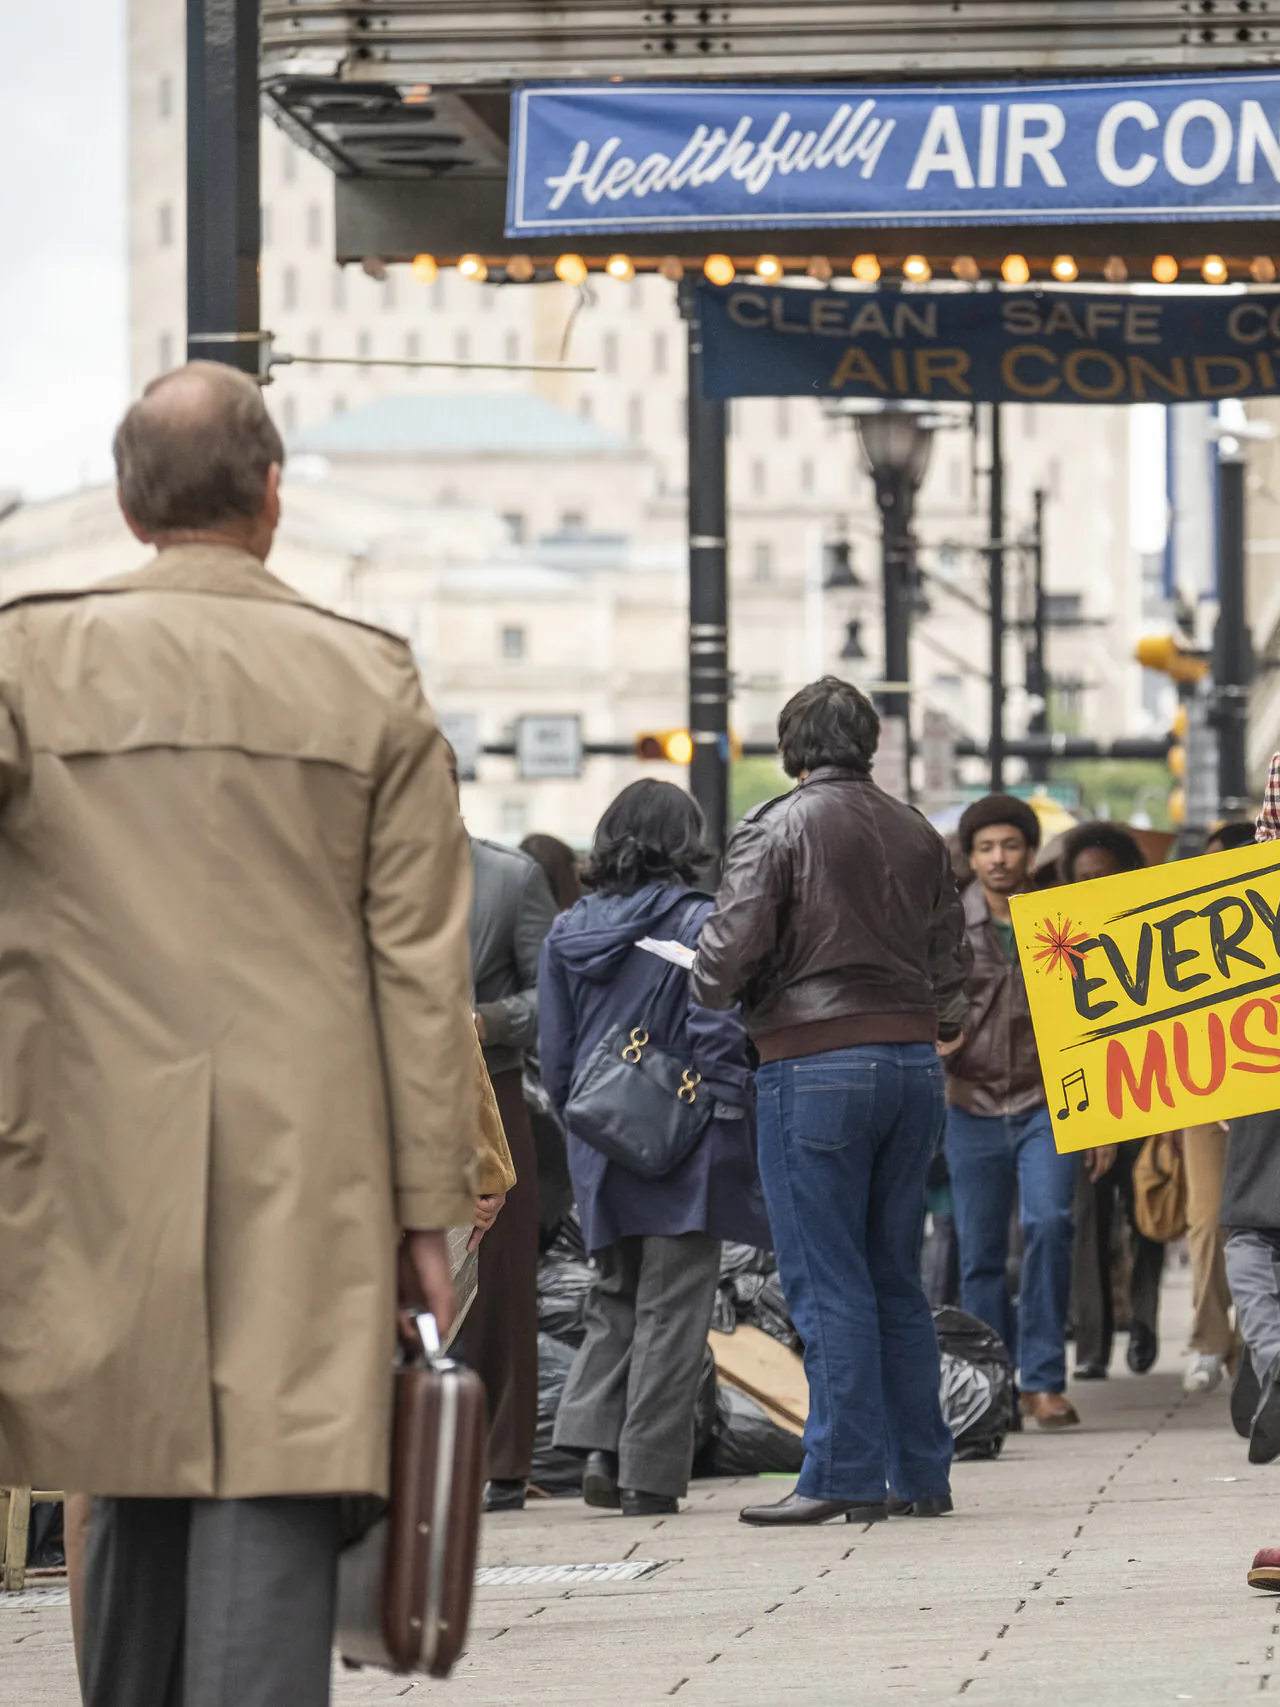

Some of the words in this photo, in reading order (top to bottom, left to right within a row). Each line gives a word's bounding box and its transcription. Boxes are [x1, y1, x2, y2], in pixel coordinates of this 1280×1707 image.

[545, 98, 896, 211] Healthfully
[906, 102, 1067, 191] AIR
[727, 291, 937, 340] CLEAN
[1003, 301, 1163, 345] SAFE
[830, 347, 972, 396] AIR
